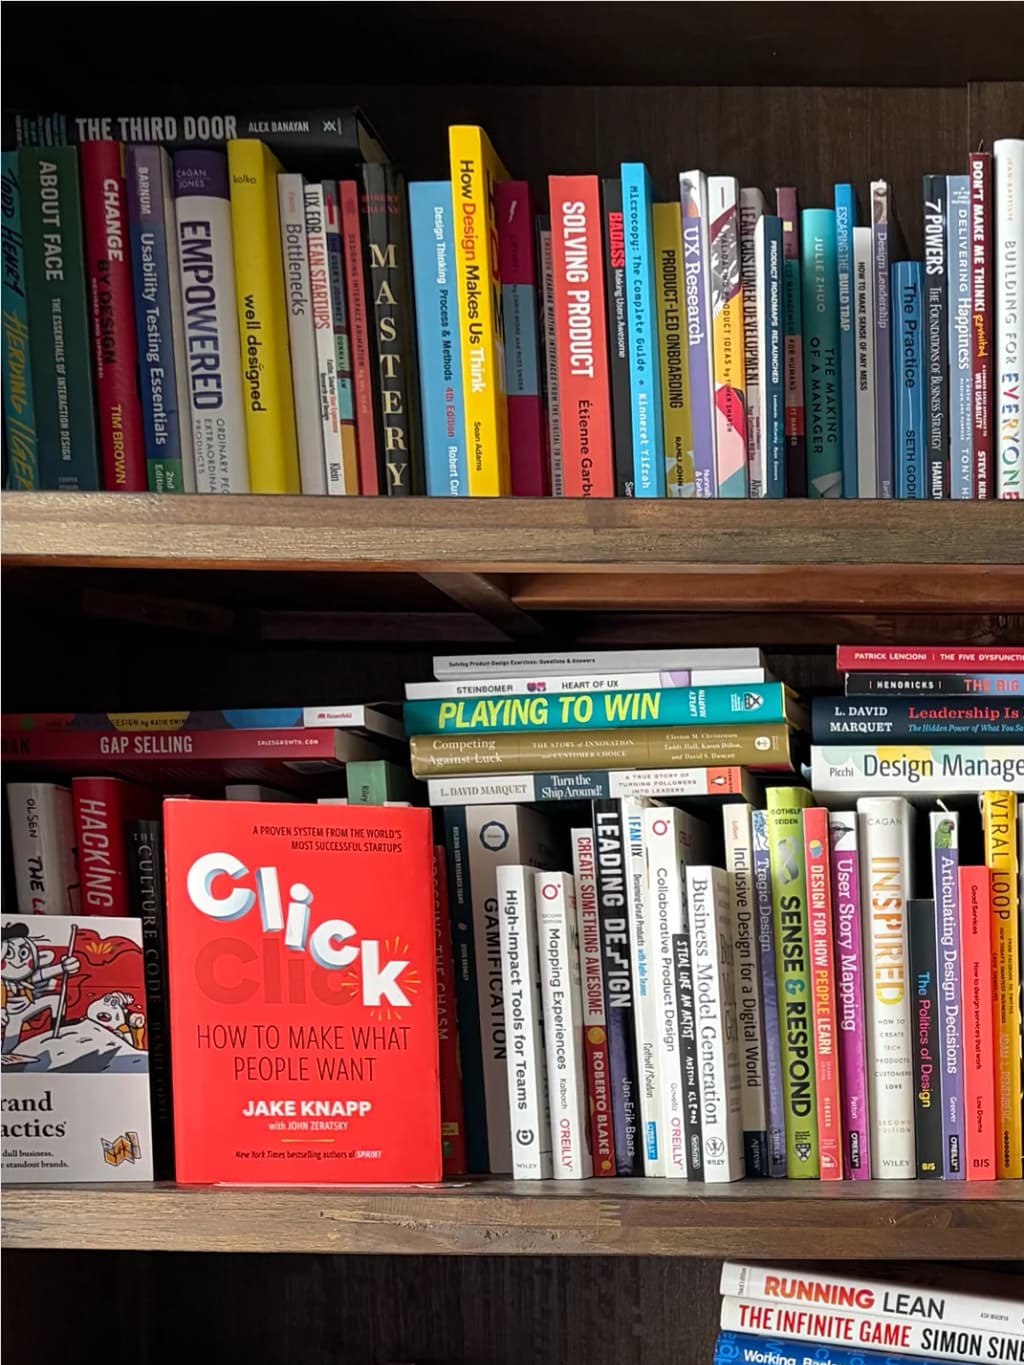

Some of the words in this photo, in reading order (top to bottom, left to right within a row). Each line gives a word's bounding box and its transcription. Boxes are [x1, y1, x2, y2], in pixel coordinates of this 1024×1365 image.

[76, 117, 111, 141] THE
[117, 117, 175, 140] THIRD
[182, 116, 237, 139] DOOR
[248, 121, 270, 132] ALEX
[39, 160, 60, 227] ABOUT
[460, 160, 474, 199] How
[461, 203, 478, 260] Design
[562, 201, 589, 282] SOLVING
[684, 226, 700, 257] UX
[44, 234, 64, 280] FACE
[466, 265, 482, 319] Makes
[686, 261, 704, 346] Research
[179, 220, 224, 410] EMPOWERED
[245, 294, 256, 331] well
[468, 323, 483, 344] Us
[567, 290, 594, 379] PRODUCT
[247, 335, 267, 412] designed
[369, 243, 407, 486] MASTERY
[470, 347, 486, 393] Think
[562, 681, 589, 690] HEART
[592, 681, 604, 689] OF
[607, 680, 618, 688] UX
[438, 697, 548, 729] PLAYING
[560, 696, 592, 724] TO
[604, 693, 661, 721] WIN
[908, 706, 1000, 722] Leadership
[1004, 706, 1018, 719] Is
[100, 737, 129, 754] GAP
[135, 735, 192, 755] SELLING
[830, 767, 854, 777] Picchi
[863, 754, 934, 783] Design
[187, 852, 411, 1007] Click
[504, 890, 520, 985] High-Impact
[780, 895, 804, 973] SENSE
[784, 979, 804, 995] &
[511, 990, 524, 1030] Tools
[197, 1025, 251, 1050] HOW
[256, 1026, 280, 1050] TO
[288, 1026, 344, 1050] MAKE
[350, 1027, 409, 1050] WHAT
[514, 1035, 526, 1056] for
[234, 1057, 310, 1081] PEOPLE
[316, 1057, 376, 1081] WANT
[785, 1001, 811, 1117] RESPOND
[515, 1061, 528, 1110] Teams
[242, 1100, 296, 1117] JAKE
[301, 1101, 372, 1117] KNAPP
[269, 1122, 286, 1130] with
[288, 1122, 308, 1130] JOHN
[310, 1122, 348, 1131] ZERATSKY
[764, 1276, 874, 1309] RUNNING
[883, 1291, 945, 1320] LEAN
[739, 1305, 773, 1330] THE
[776, 1307, 855, 1341] INFINITE
[859, 1322, 912, 1348] GAME
[921, 1328, 986, 1357] SIMON
